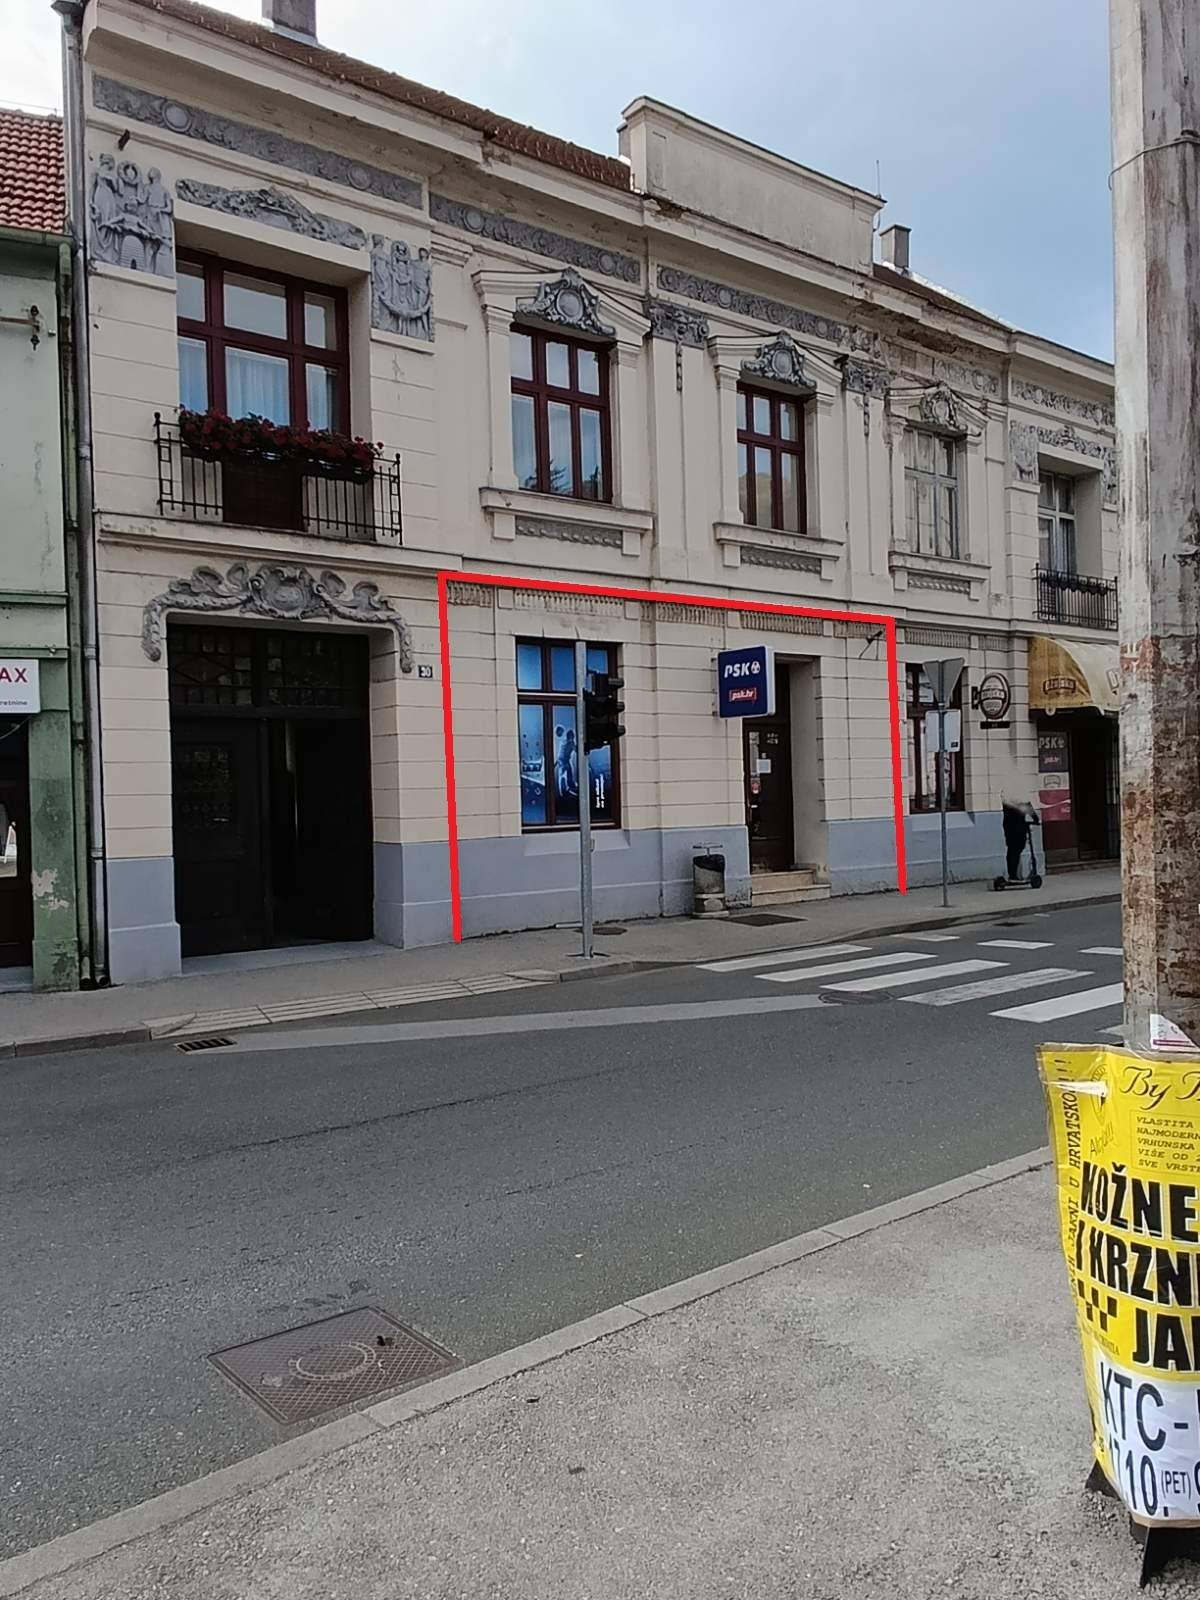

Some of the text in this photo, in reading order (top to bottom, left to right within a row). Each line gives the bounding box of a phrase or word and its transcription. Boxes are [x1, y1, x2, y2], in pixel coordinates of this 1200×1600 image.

[724, 662, 750, 678] PSK
[1039, 737, 1057, 749] PSK
[1119, 1066, 1171, 1111] By
[1136, 1116, 1193, 1128] VLASTITA
[1138, 1137, 1195, 1150] VRHUNSKA
[1138, 1148, 1165, 1158] VIŠE
[1172, 1152, 1189, 1160] OD
[1138, 1159, 1158, 1168] SVE
[1069, 1176, 1080, 1189] U
[1081, 1160, 1199, 1243] KOŽNE
[1089, 1226, 1200, 1307] KRZN
